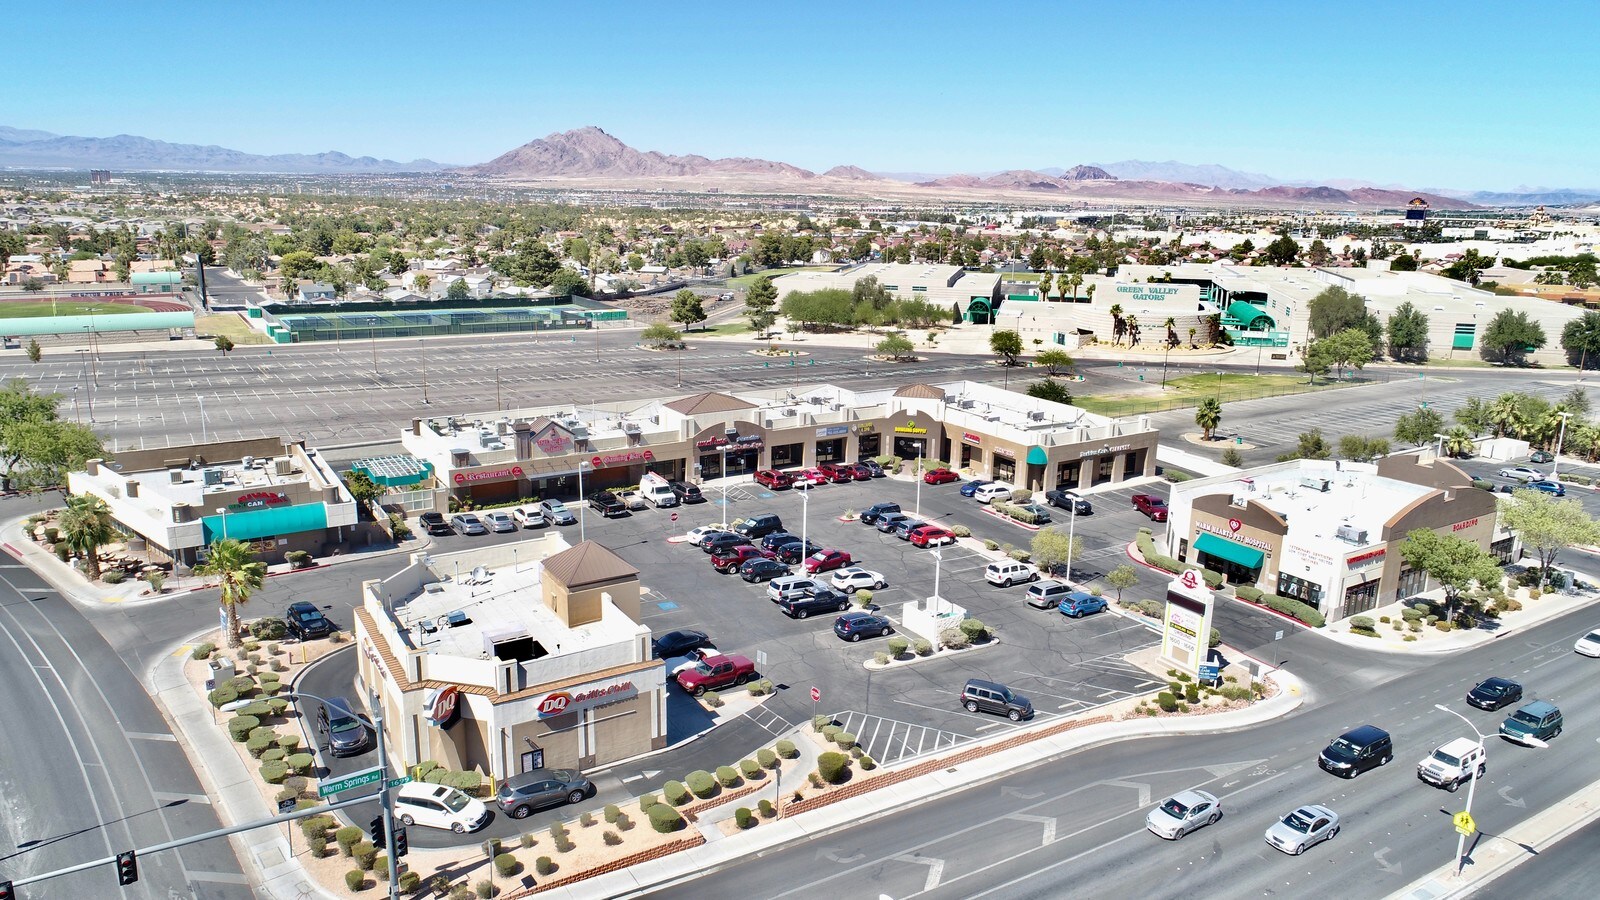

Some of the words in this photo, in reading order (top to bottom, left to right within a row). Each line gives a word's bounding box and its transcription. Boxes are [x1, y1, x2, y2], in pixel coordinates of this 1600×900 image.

[1148, 287, 1179, 295] VALLEY
[466, 469, 510, 481] Restaurant
[1452, 518, 1478, 532] BOARDING
[1196, 520, 1211, 531] WARM
[1211, 525, 1233, 538] HEARTS
[1233, 532, 1244, 542] PET
[1244, 536, 1273, 551] HOSPITAL
[437, 692, 456, 719] DQ
[543, 696, 566, 713] DQ
[575, 690, 600, 703] Grill
[607, 681, 631, 695] Chill
[321, 783, 343, 795] Warm
[343, 775, 370, 788] Springs
